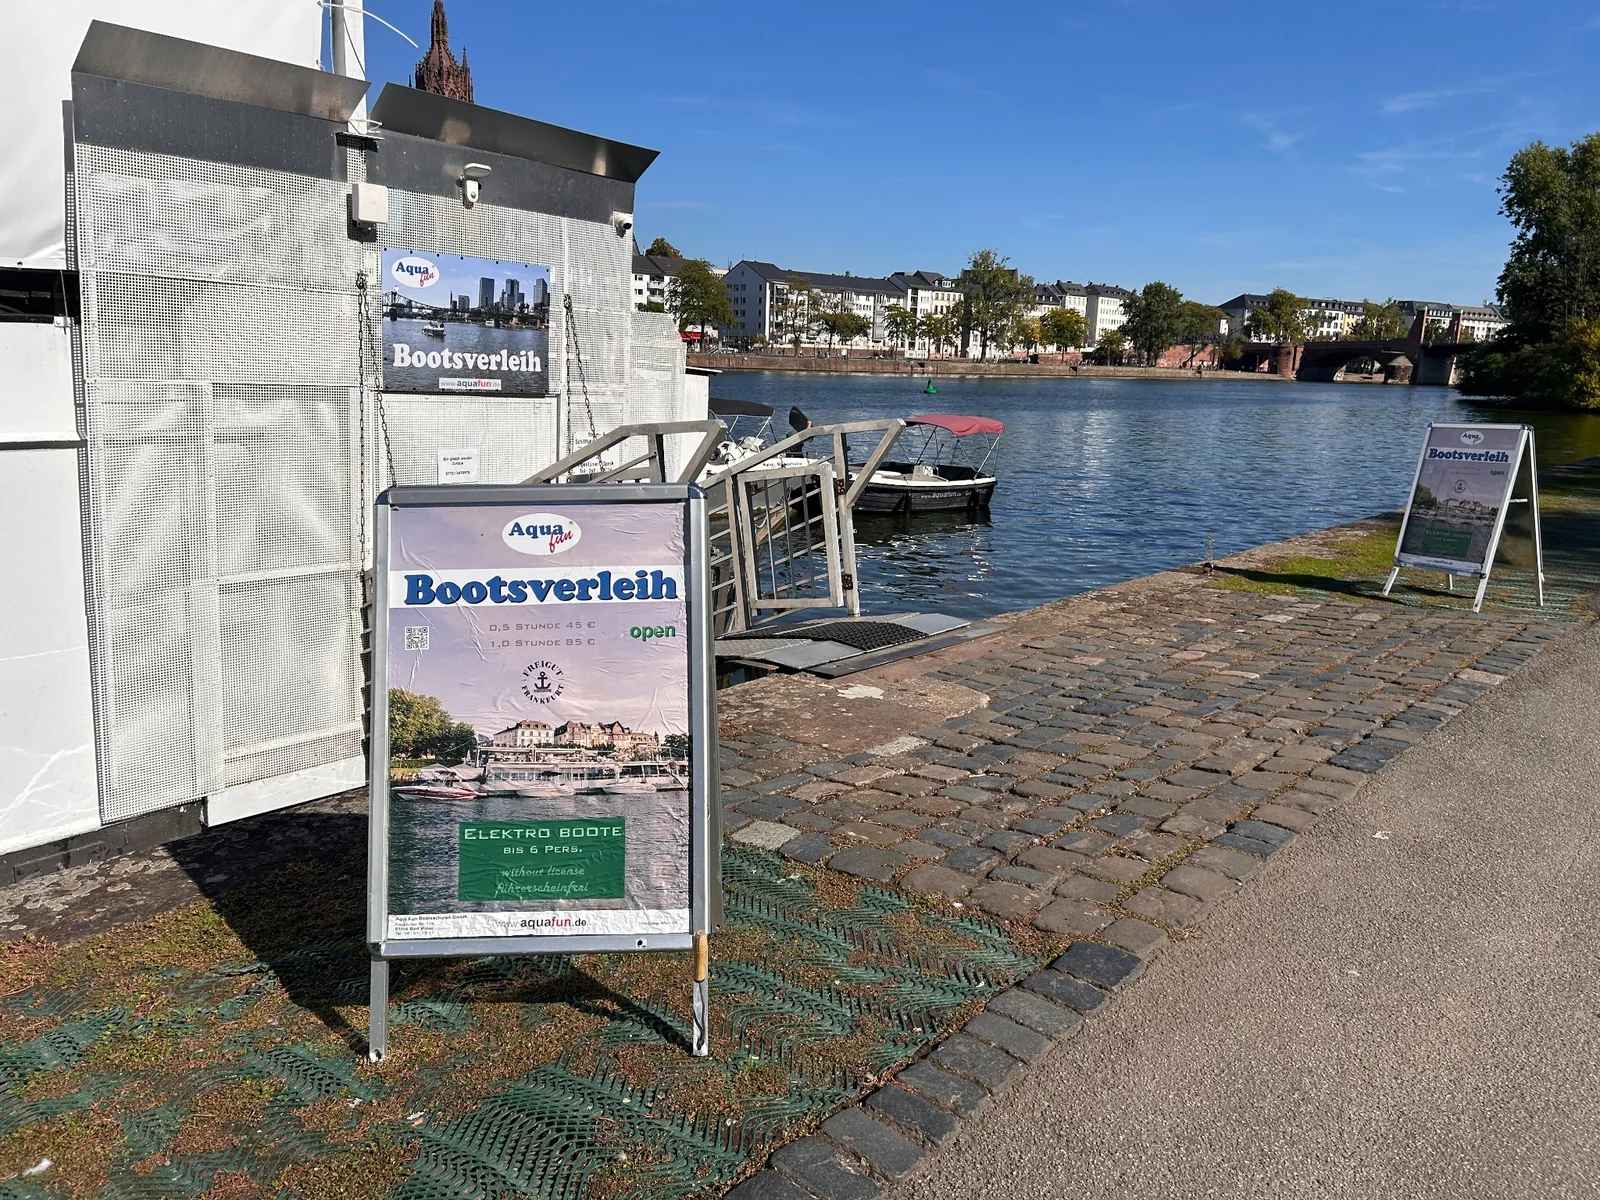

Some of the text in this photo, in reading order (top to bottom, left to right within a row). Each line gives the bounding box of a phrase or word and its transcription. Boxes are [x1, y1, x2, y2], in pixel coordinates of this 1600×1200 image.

[396, 261, 429, 275] Aqua
[419, 271, 435, 288] fun
[392, 343, 542, 373] Bootsverleih
[440, 378, 501, 388] www.aquafun.de
[1428, 448, 1510, 463] Bootsverleih
[508, 521, 564, 539] Aqua
[548, 530, 574, 554] fun
[403, 569, 678, 606] Bootsverleih
[489, 623, 510, 633] 0,5
[566, 621, 583, 629] 45
[587, 621, 596, 629] €
[629, 622, 676, 642] open
[490, 640, 510, 648] 1,0
[565, 638, 583, 646] 85
[587, 638, 596, 646] €
[522, 660, 564, 677] FREIGUT
[521, 684, 565, 704] FRANKFURT
[559, 826, 623, 838] BOOTE
[530, 845, 539, 854] 6
[501, 865, 586, 877] without license
[493, 880, 589, 899] führerscheinfrei
[494, 916, 588, 930] www.aquafun.de
